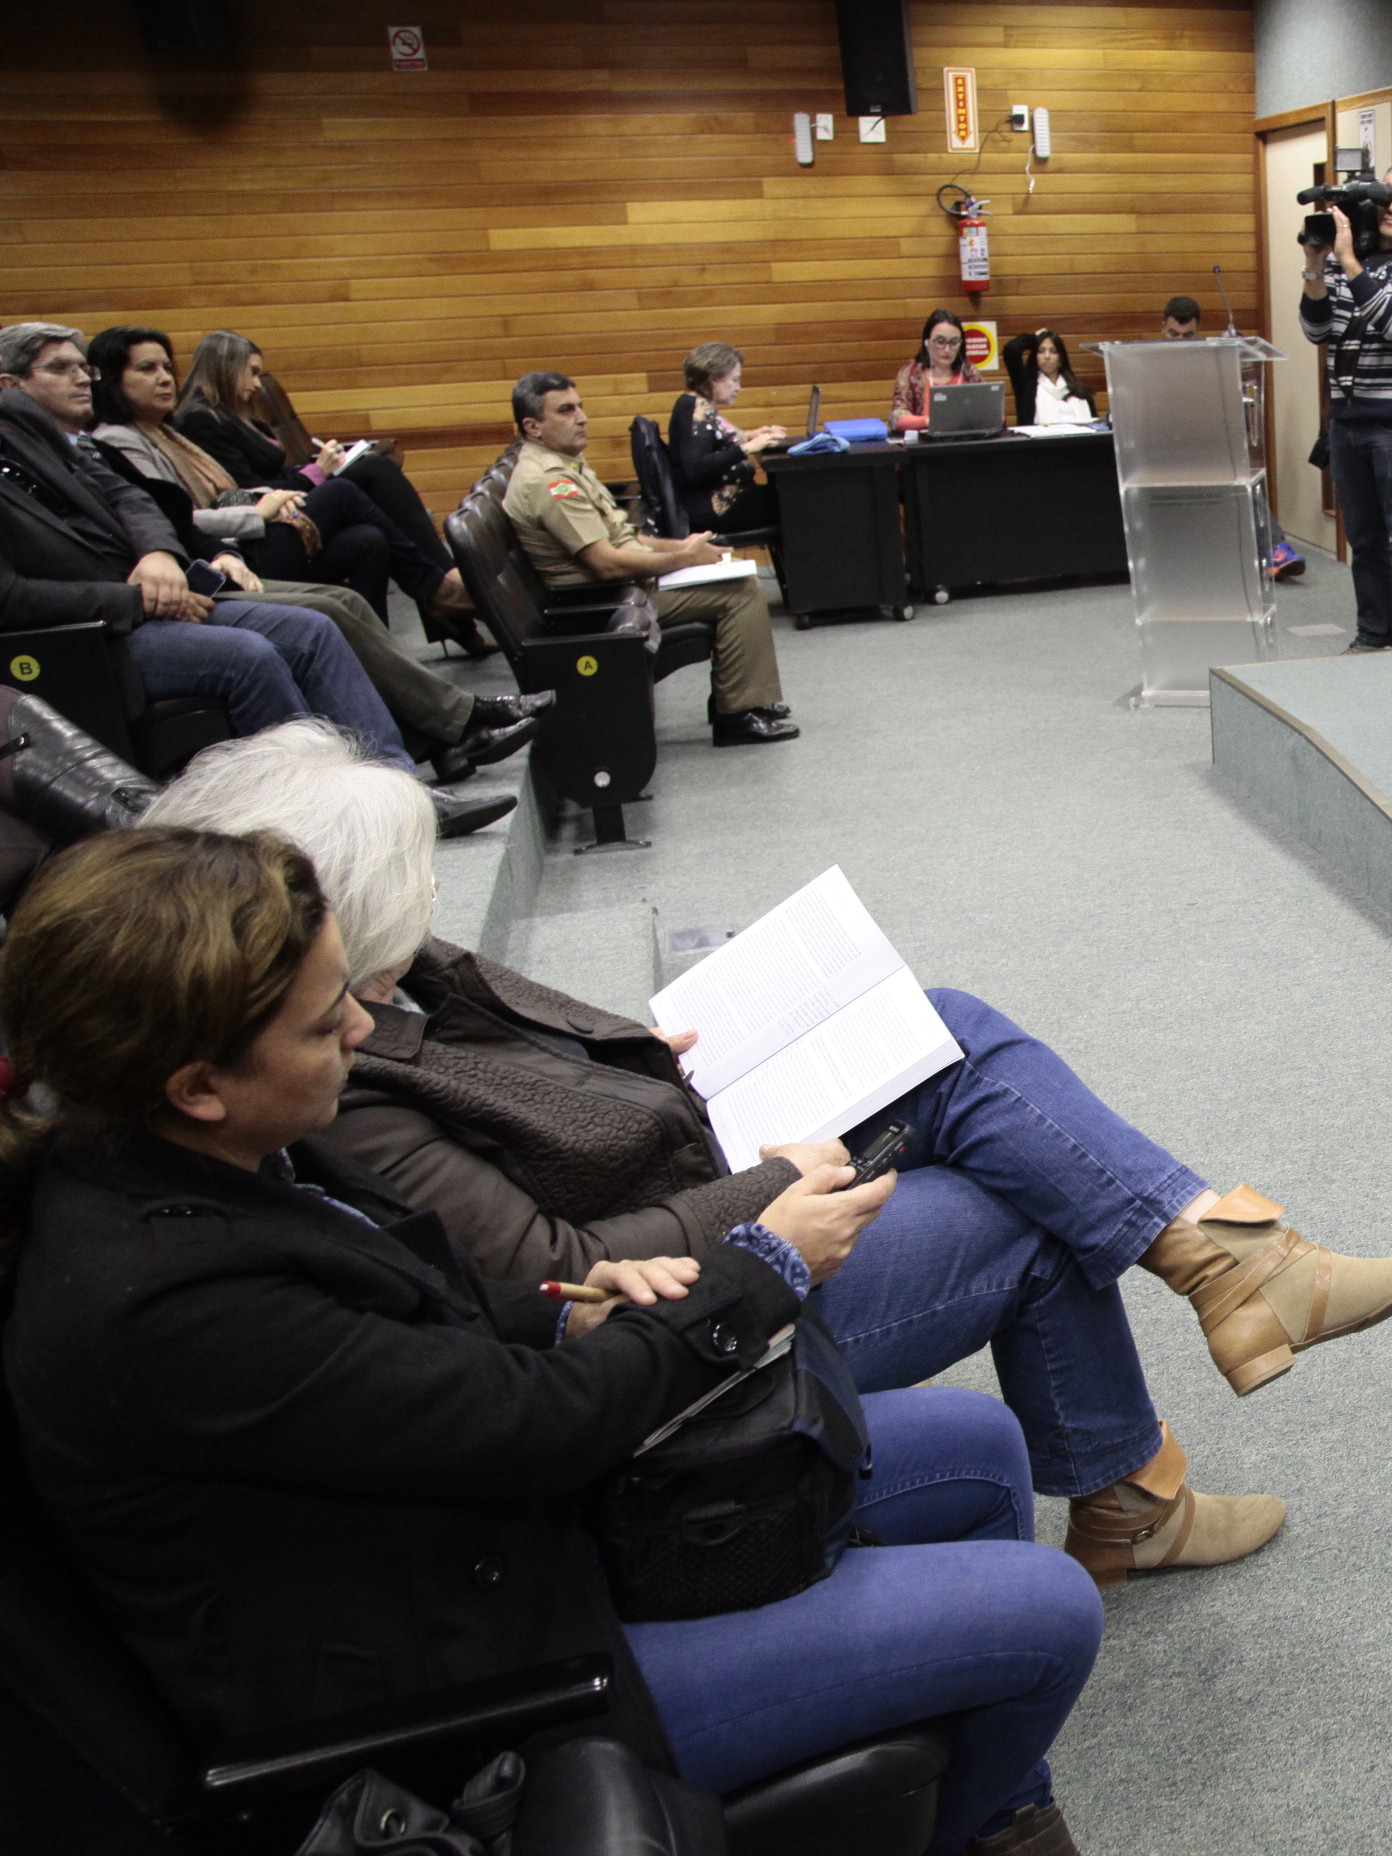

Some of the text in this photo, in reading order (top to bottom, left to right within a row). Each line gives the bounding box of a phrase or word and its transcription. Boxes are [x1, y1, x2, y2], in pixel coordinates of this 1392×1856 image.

[956, 78, 967, 136] EXTINTOR
[19, 662, 33, 675] B
[584, 660, 594, 671] A
